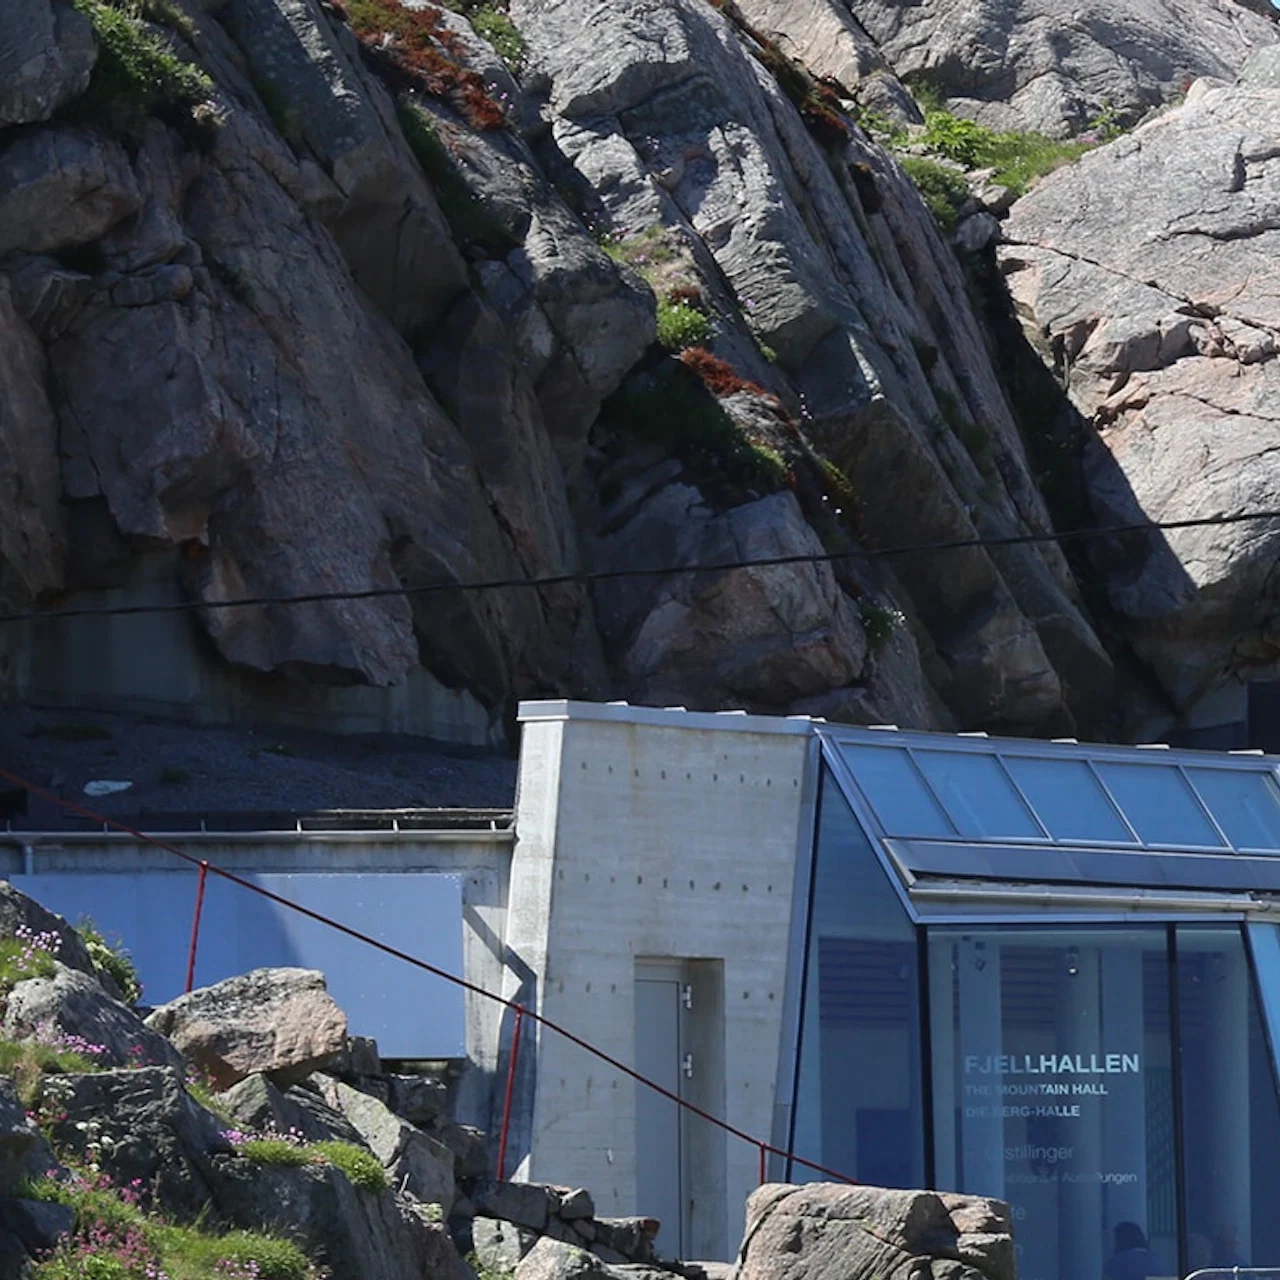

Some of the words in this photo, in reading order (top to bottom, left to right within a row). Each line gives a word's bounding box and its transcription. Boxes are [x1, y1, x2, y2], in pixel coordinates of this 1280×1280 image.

[964, 1053, 1140, 1074] FJELLHALLEN
[964, 1083, 993, 1097] THE
[995, 1083, 1069, 1097] MOUNTAIN
[1072, 1083, 1109, 1097] HALL
[984, 1145, 1075, 1163] stillinger
